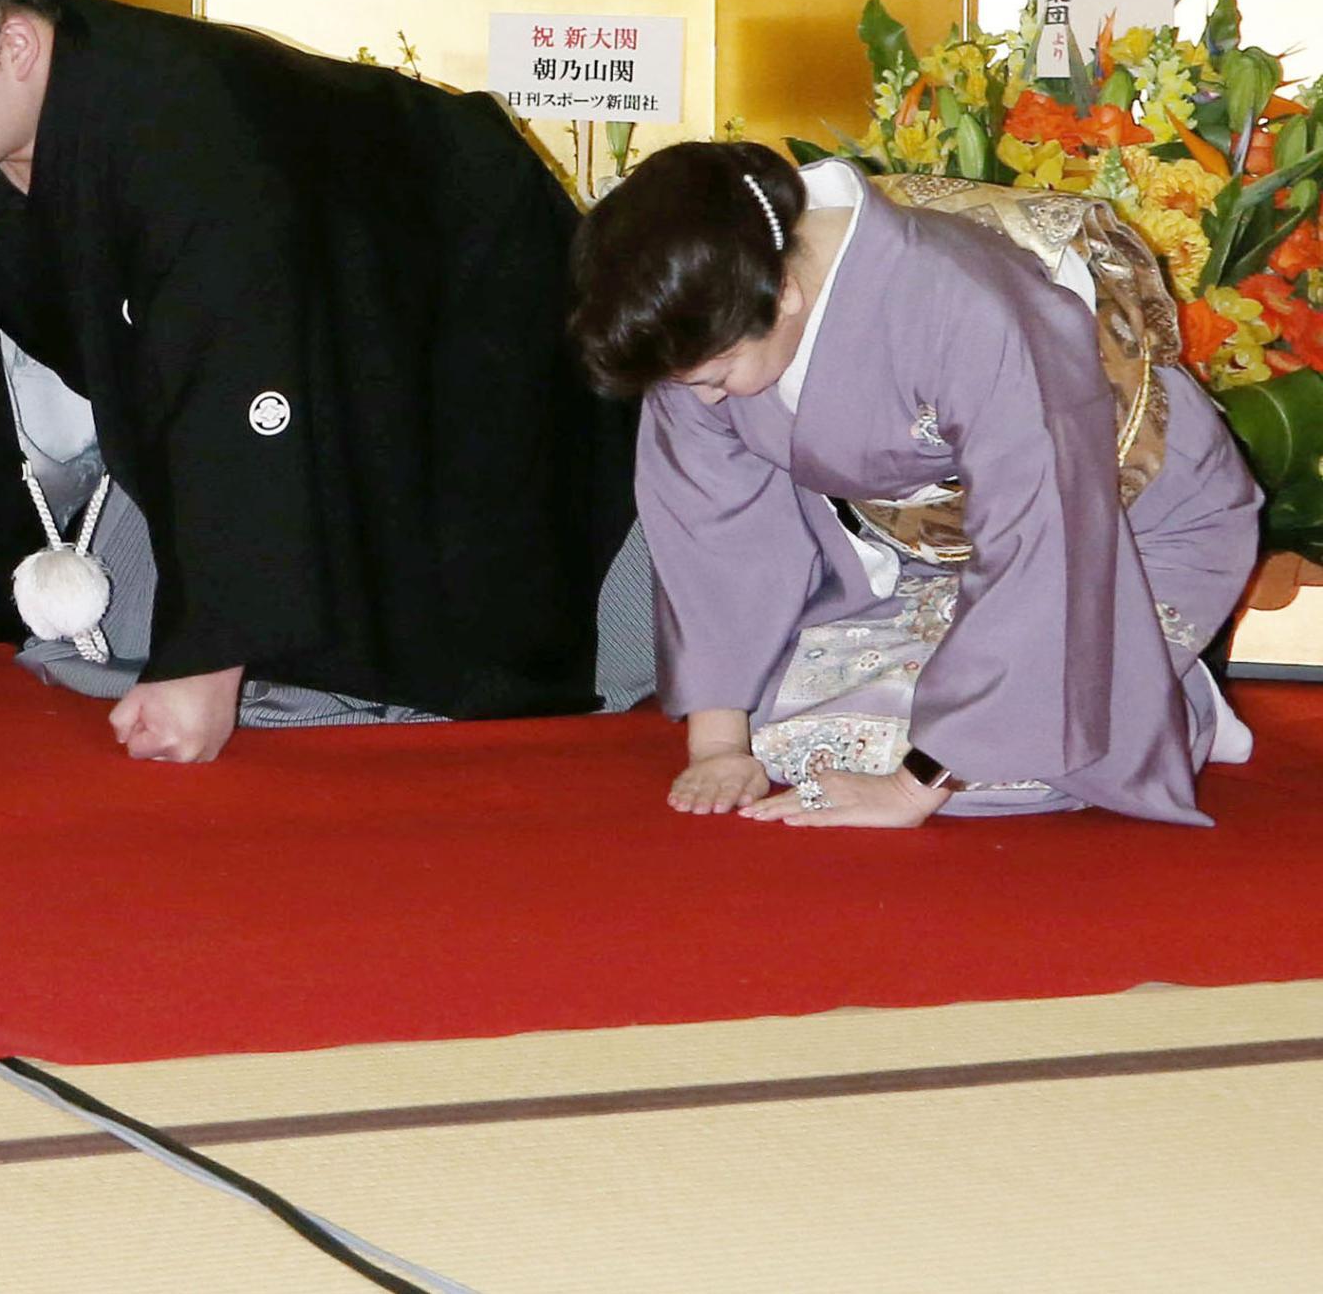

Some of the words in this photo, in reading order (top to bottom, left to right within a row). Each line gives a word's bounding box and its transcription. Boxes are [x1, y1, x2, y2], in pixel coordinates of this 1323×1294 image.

[531, 25, 555, 49] 祝
[563, 26, 638, 51] 新大関
[533, 57, 635, 82] 朝乃山関
[507, 91, 659, 111] 日刊スポーツ新聞社
